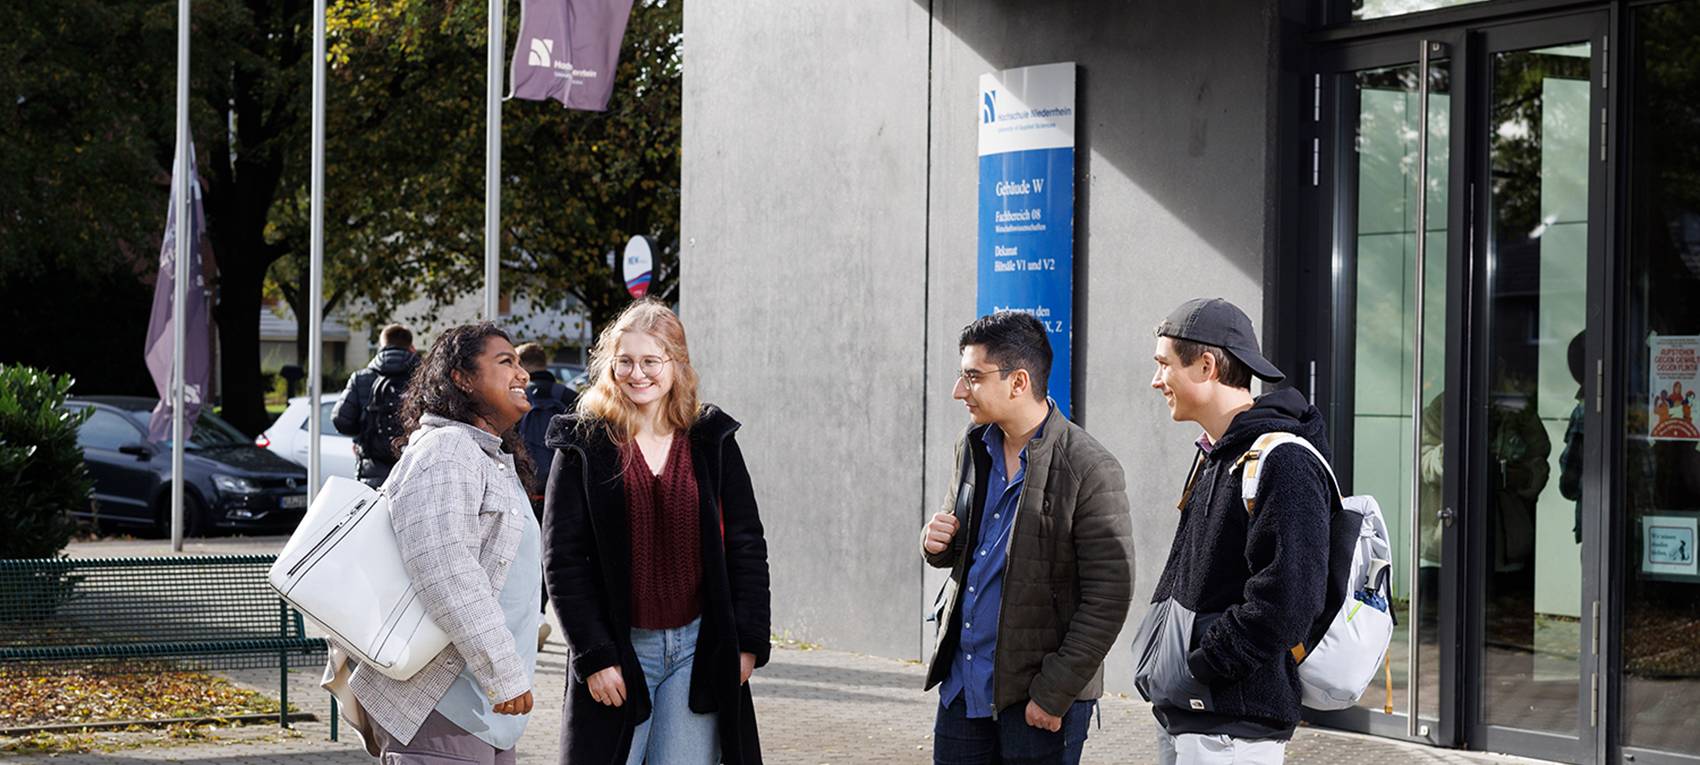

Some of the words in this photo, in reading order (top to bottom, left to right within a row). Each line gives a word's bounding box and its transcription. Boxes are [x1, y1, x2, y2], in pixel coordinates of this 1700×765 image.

[1031, 107, 1072, 118] Niederrhein
[996, 179, 1030, 196] Gebäude
[1032, 179, 1044, 193] W
[996, 208, 1030, 222] Fachbereich
[1031, 208, 1041, 220] 08
[995, 244, 1018, 257] Dekanat
[1016, 259, 1026, 271] V1
[1027, 259, 1042, 271] und
[1043, 258, 1055, 271] V2
[1036, 305, 1050, 317] den
[1055, 320, 1063, 333] Z
